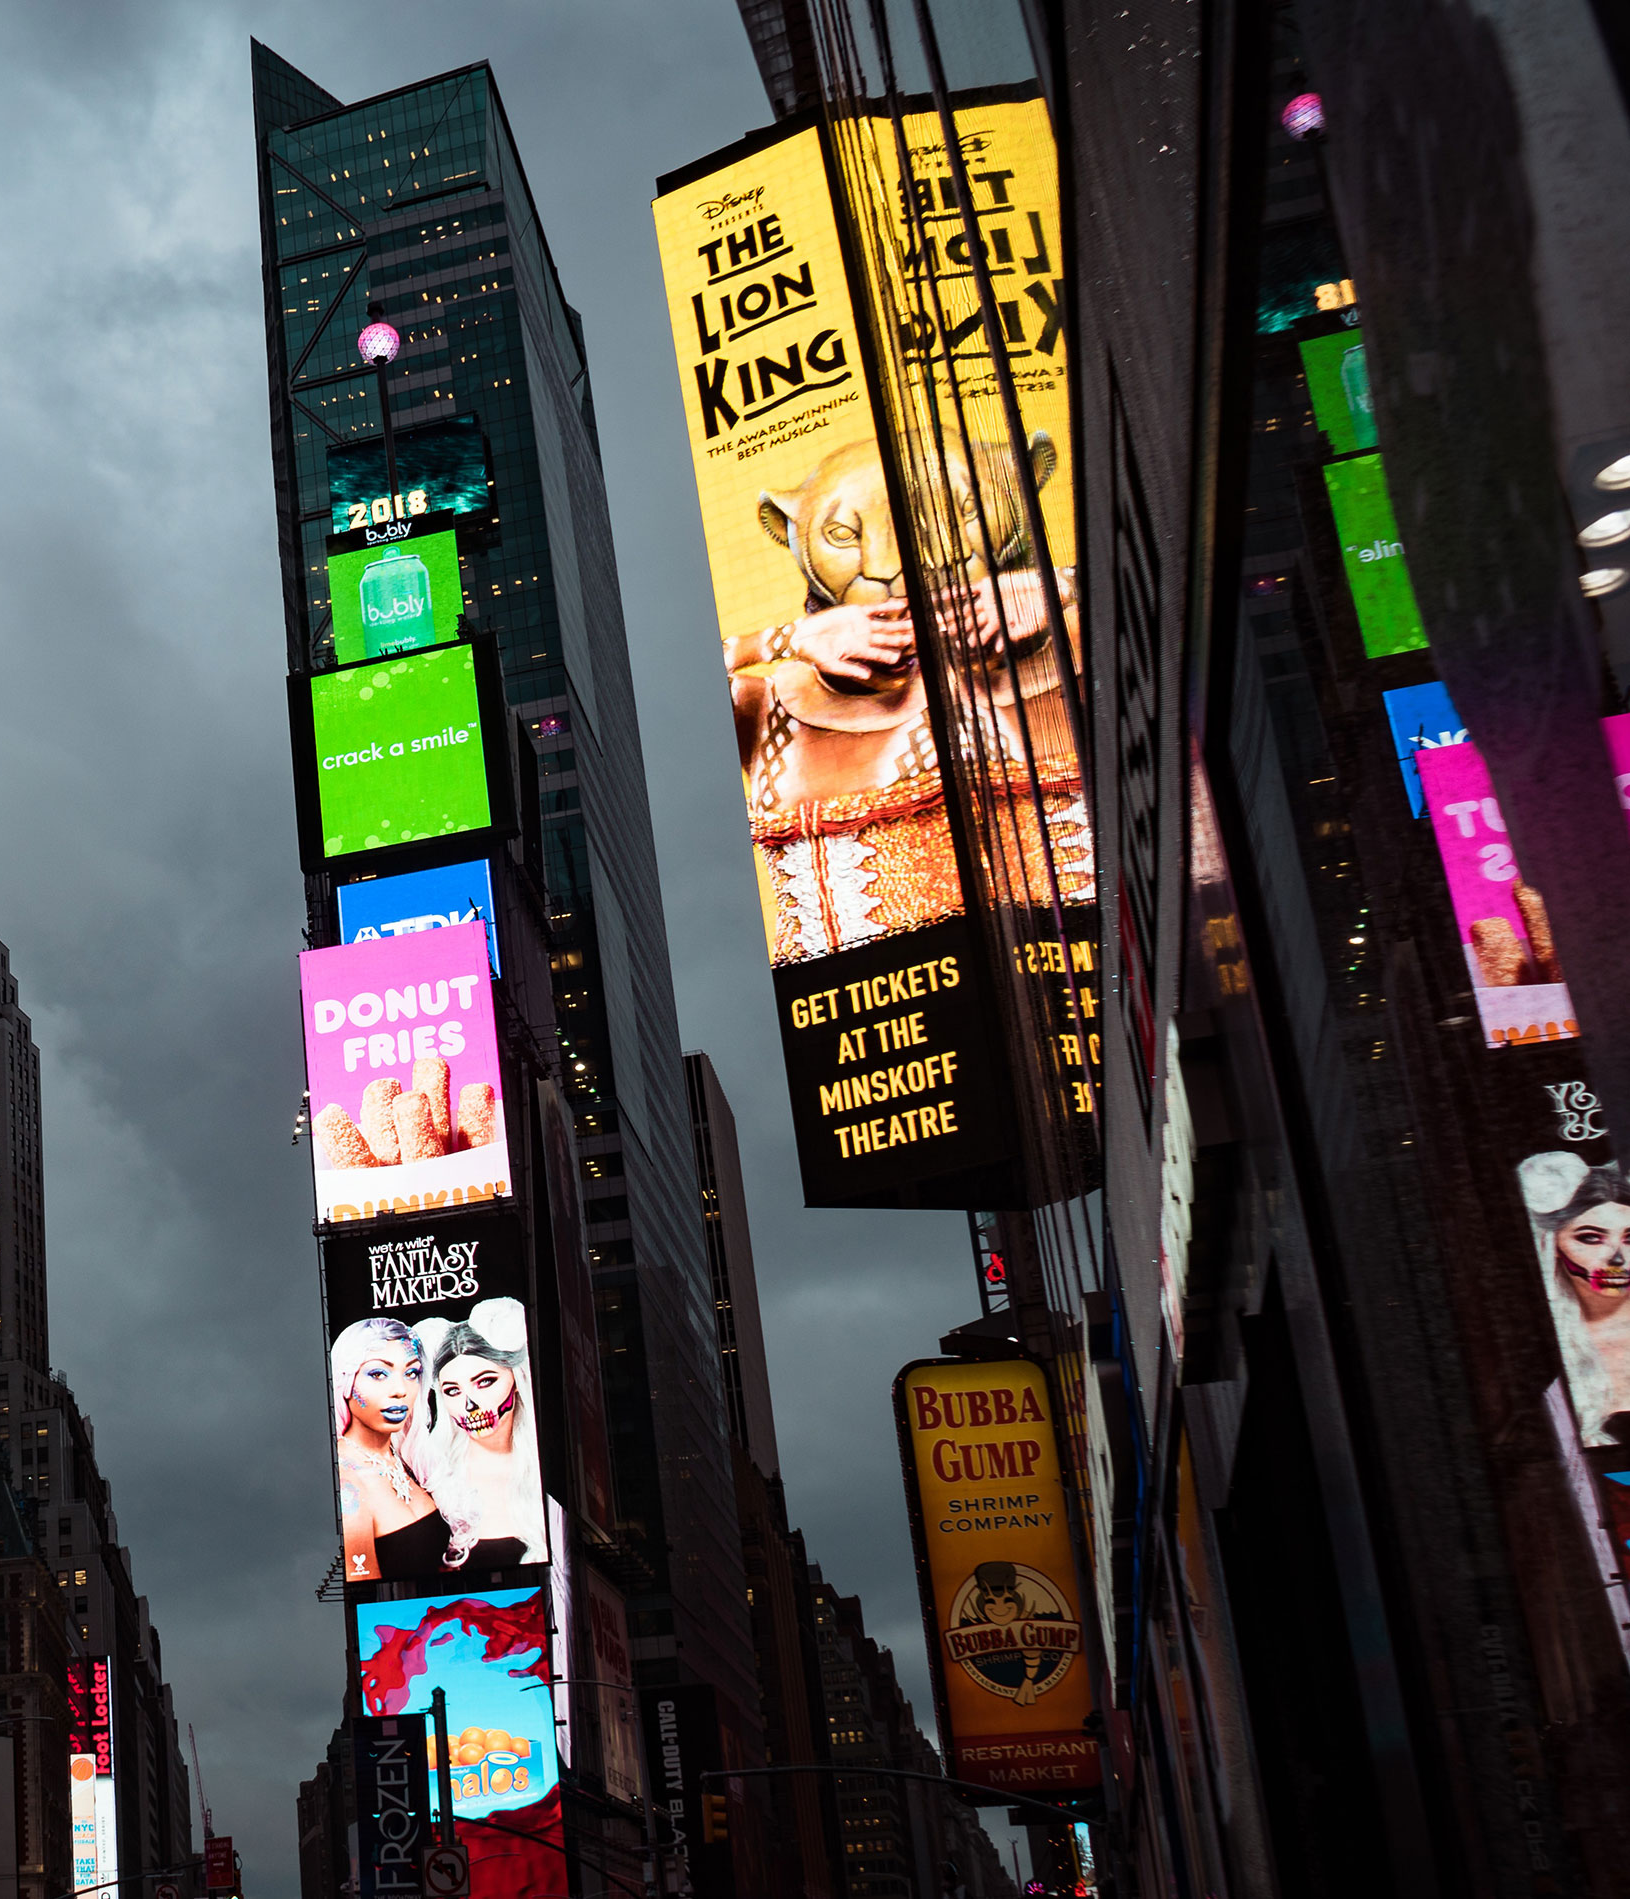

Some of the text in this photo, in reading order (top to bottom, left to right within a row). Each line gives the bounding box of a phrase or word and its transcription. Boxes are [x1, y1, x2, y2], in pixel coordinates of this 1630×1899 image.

[711, 204, 763, 232] PRESENTS
[698, 214, 784, 276] THE
[692, 261, 814, 356] LION
[694, 329, 847, 440] KING
[707, 392, 859, 459] THE AWARD-WINNING
[738, 418, 830, 461] BEST MUSICAL
[348, 490, 427, 530] 2018
[366, 522, 412, 543] bubly
[367, 595, 424, 622] bubly
[322, 743, 383, 771] crack
[389, 741, 404, 758] a
[313, 975, 479, 1034] DONUT
[791, 988, 839, 1029] GET
[845, 956, 960, 1014] TICKETS
[343, 1021, 466, 1072] FRIES
[838, 1011, 928, 1064] AT THE
[819, 1051, 957, 1116] MINSKOFF
[834, 1100, 958, 1158] THEATRE
[368, 1243, 394, 1255] wet
[370, 1241, 479, 1281] FANTASY
[372, 1268, 479, 1309] MAKERS
[912, 1386, 1046, 1430] BUBBA
[932, 1438, 1041, 1483] GUMP
[938, 1512, 1054, 1533] COMPANY
[948, 1494, 1040, 1514] SHRIMP
[949, 1622, 1078, 1658] BUBBA GUMP
[975, 1652, 1022, 1667] SHRIMP
[963, 1660, 1015, 1695] RESTAURANT
[90, 1662, 110, 1774] Foot Locker
[658, 1700, 678, 1741] CALL
[662, 1745, 684, 1791] DUTY
[961, 1740, 1098, 1762] RESTAURANT
[989, 1764, 1078, 1784] MARKET
[74, 1824, 94, 1832] NYC
[374, 1740, 420, 1891] FROZEN
